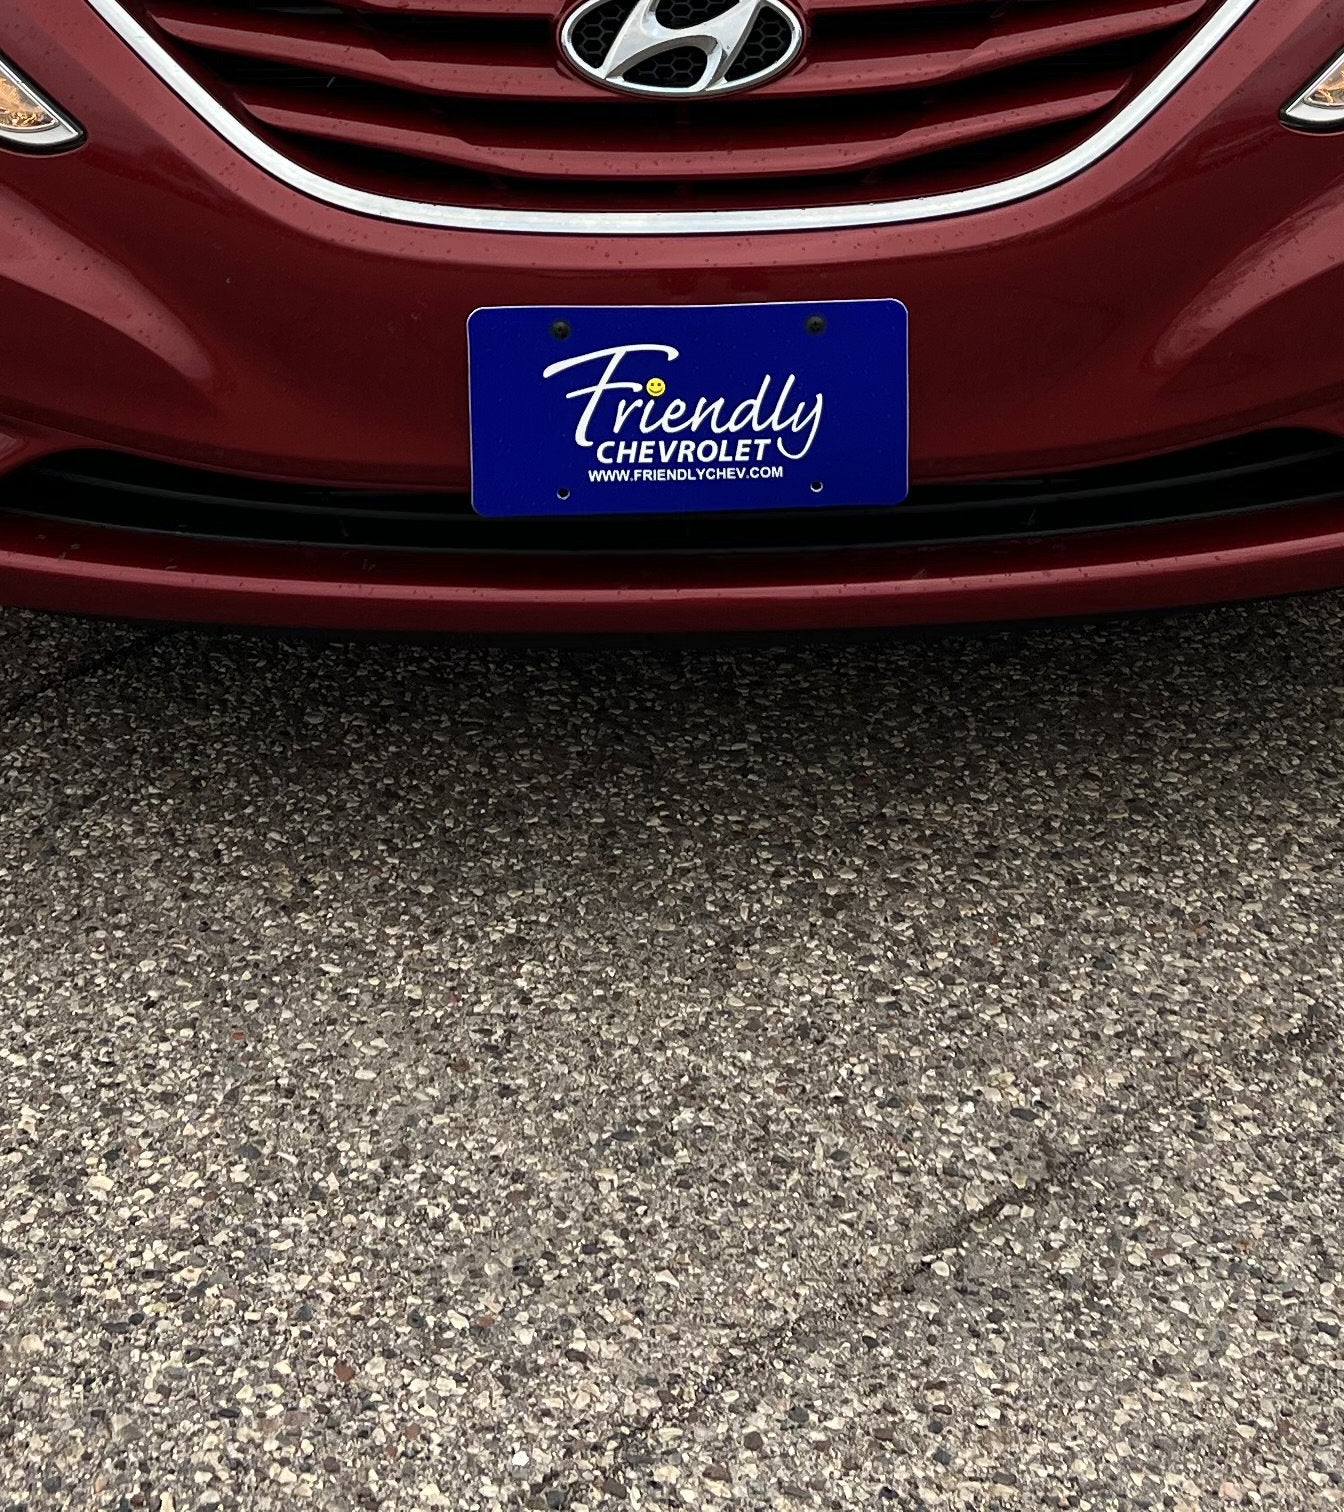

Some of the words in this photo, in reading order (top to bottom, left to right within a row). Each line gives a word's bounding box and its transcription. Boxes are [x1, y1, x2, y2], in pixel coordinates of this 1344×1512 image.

[543, 343, 823, 459] Friendly
[596, 438, 772, 464] CHEVROLET
[588, 466, 784, 482] WWW.FRIENDLYCHEV.COM
